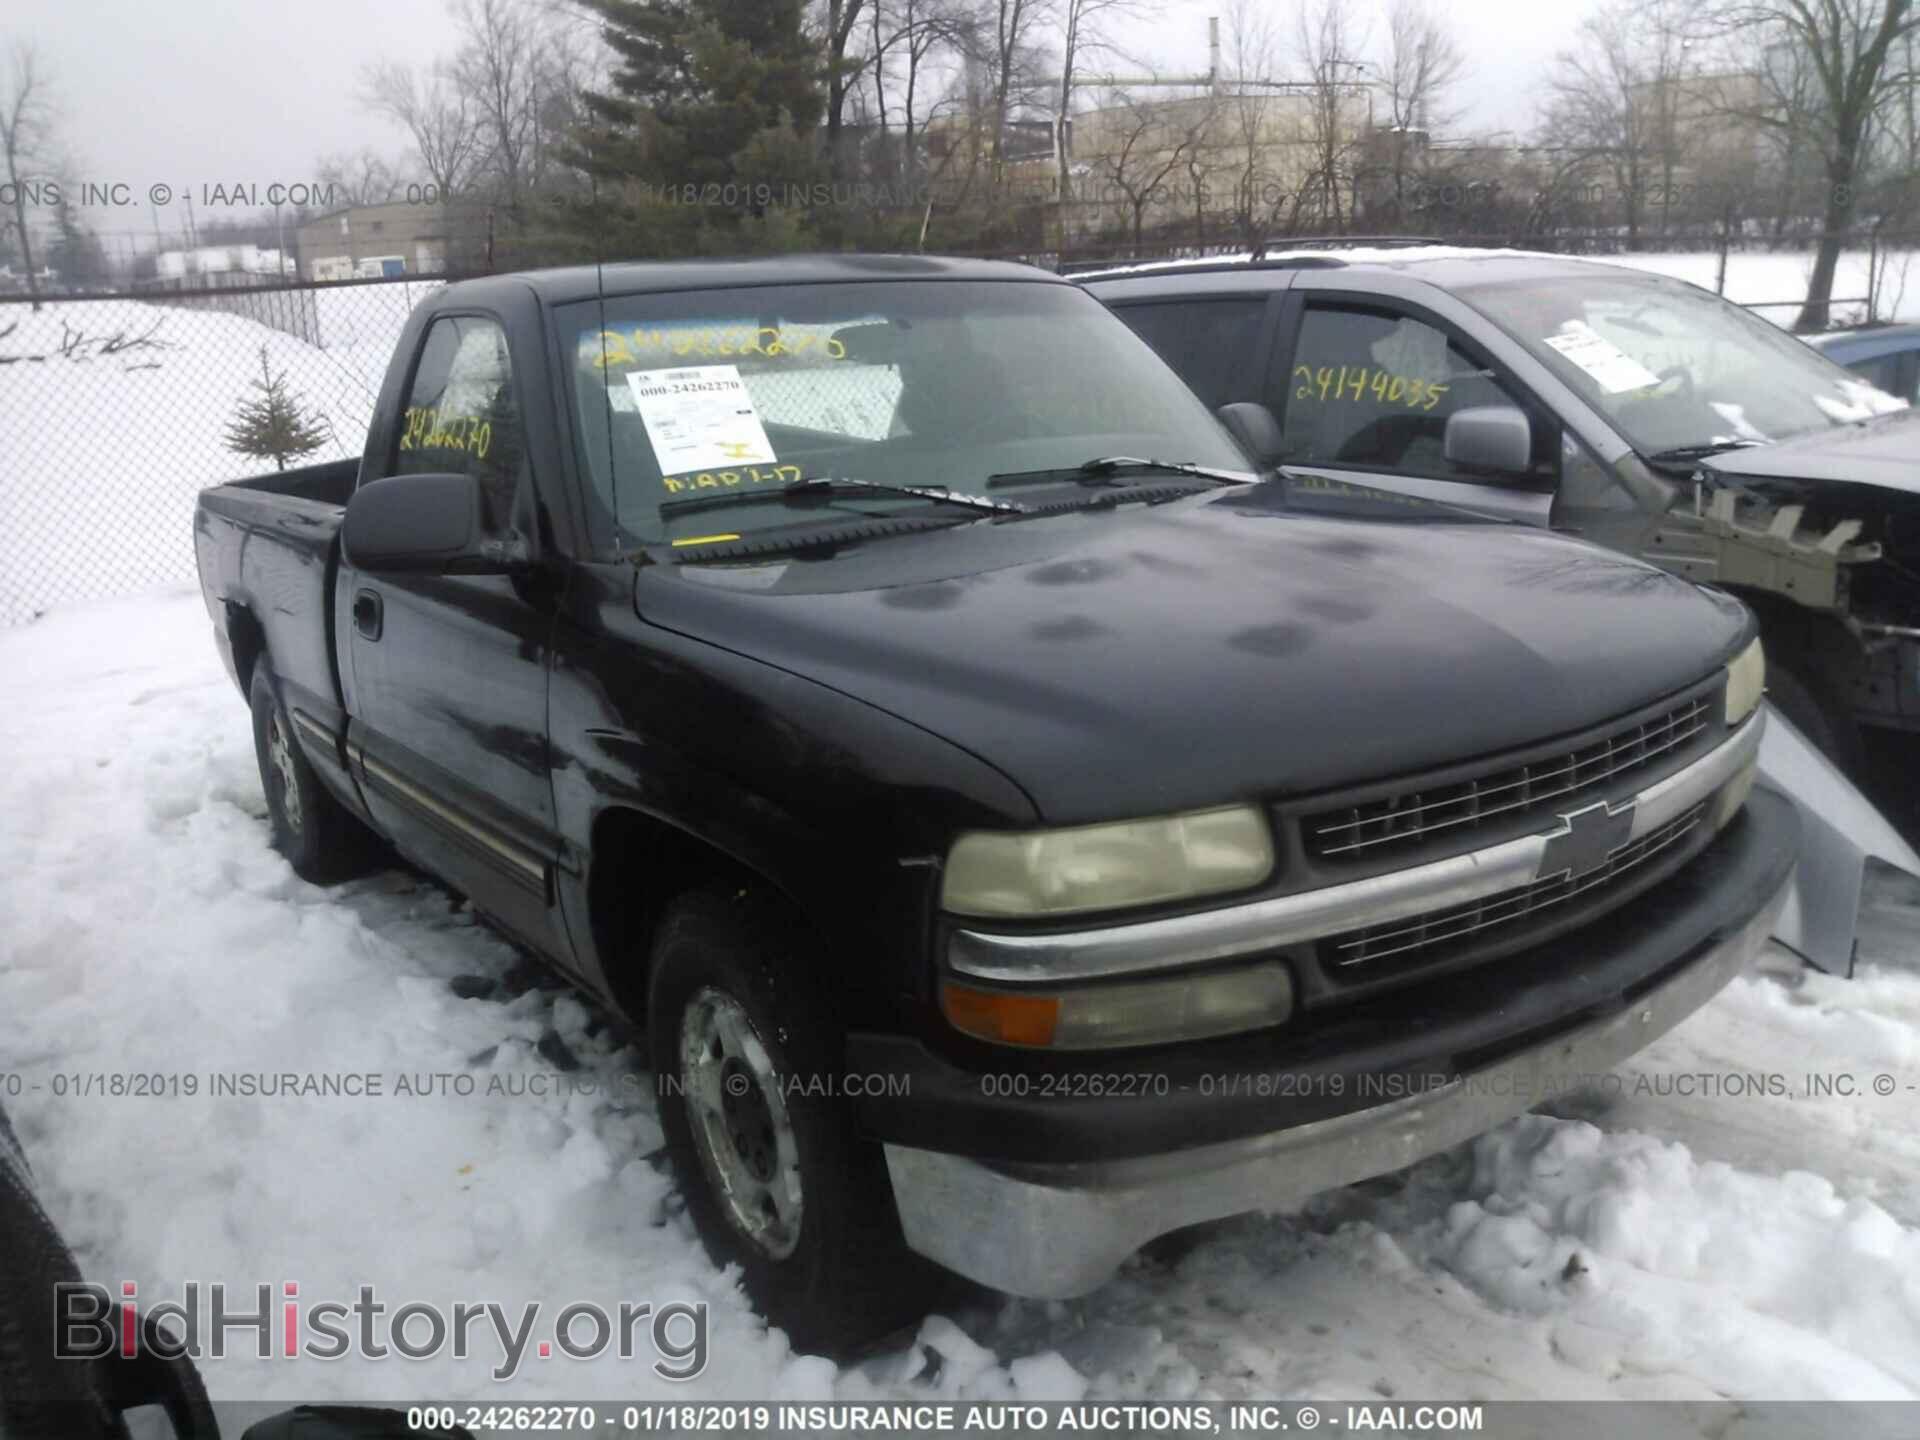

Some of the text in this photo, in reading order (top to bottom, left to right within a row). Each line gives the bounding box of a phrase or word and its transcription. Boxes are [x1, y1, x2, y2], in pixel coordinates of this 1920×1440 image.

[639, 380, 741, 397] 000-24262270
[1294, 364, 1450, 411] 24144035
[399, 405, 491, 458] 24262270
